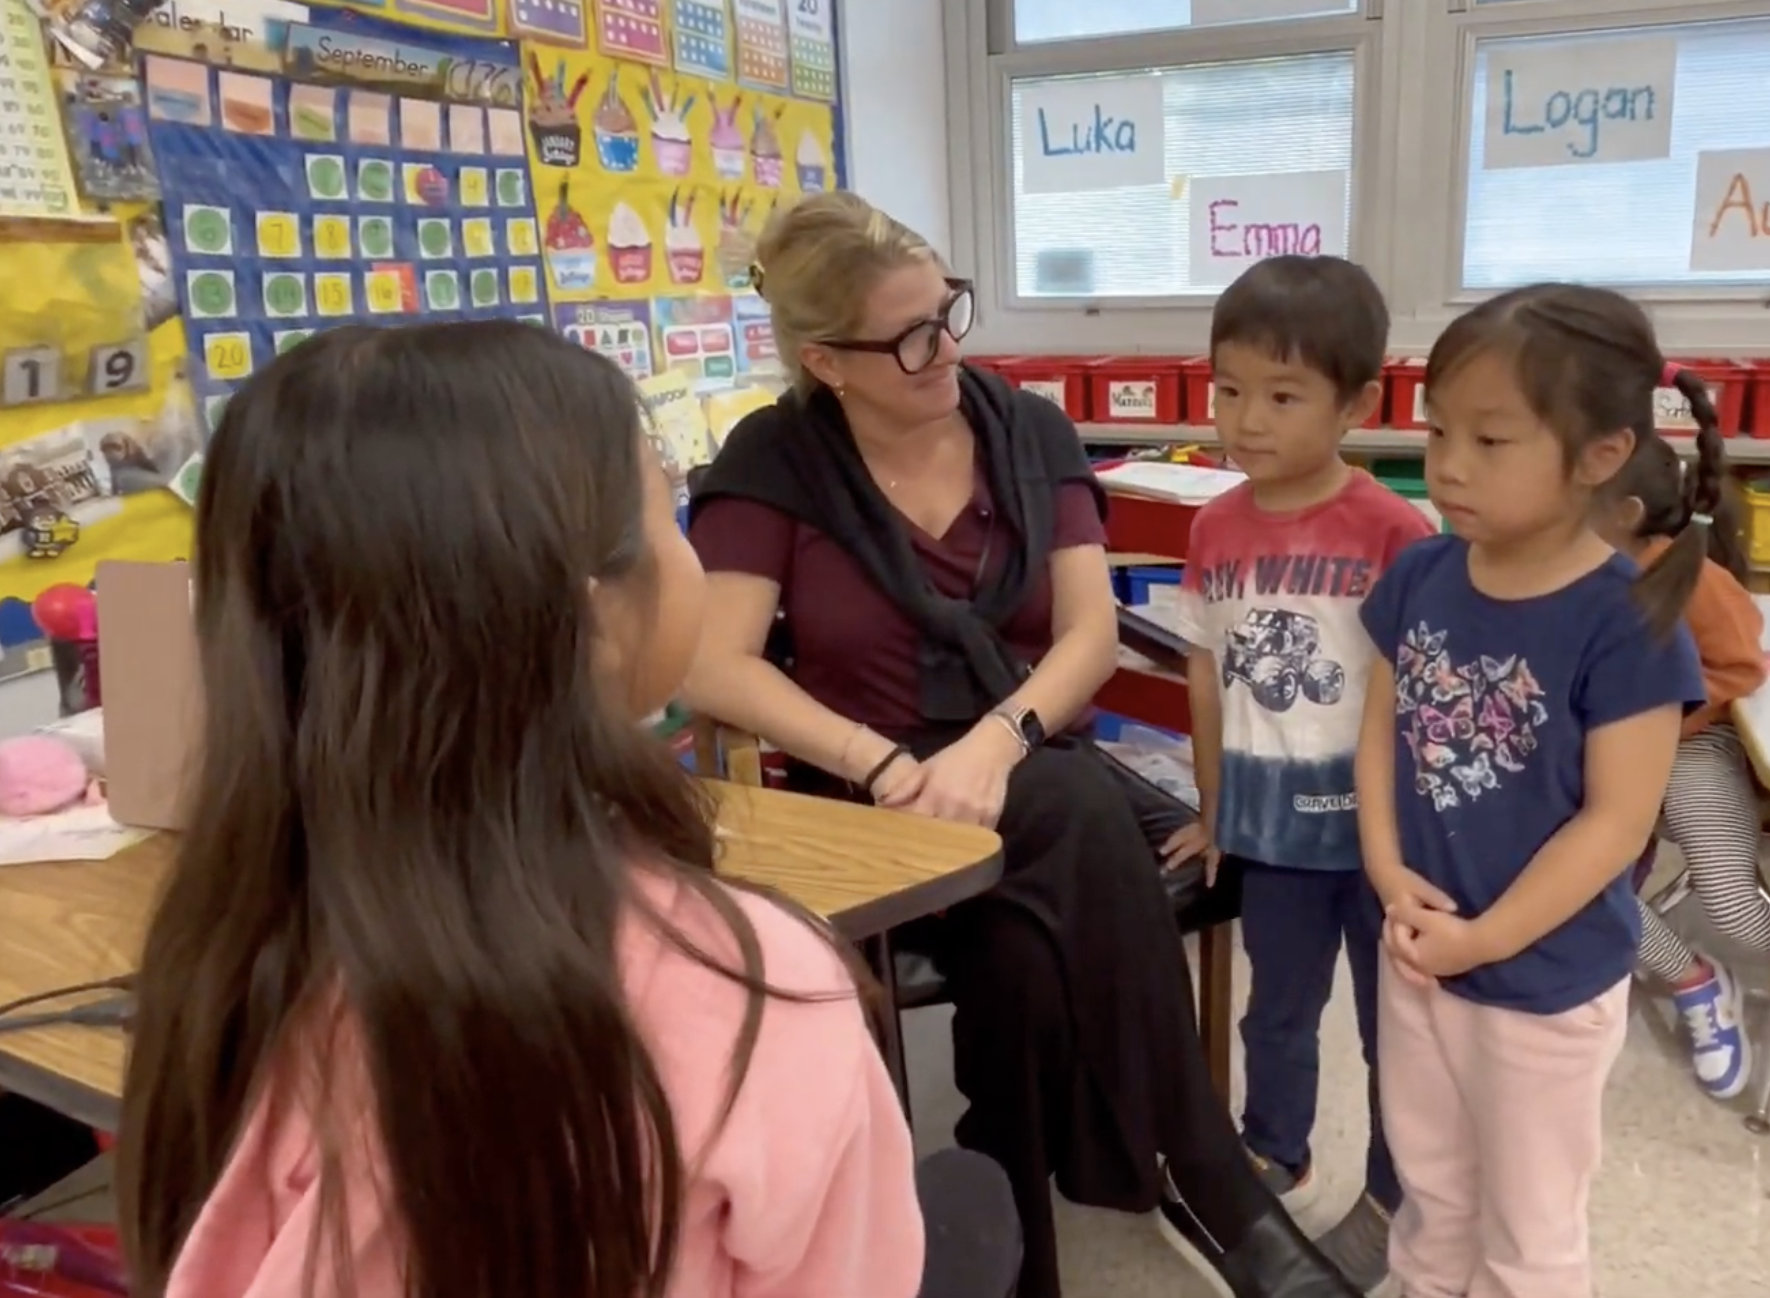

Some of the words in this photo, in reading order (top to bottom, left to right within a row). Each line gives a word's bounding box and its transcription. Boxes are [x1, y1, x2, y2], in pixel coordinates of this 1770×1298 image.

[147, 0, 254, 43] aledar
[317, 36, 430, 78] September
[1038, 103, 1136, 156] Luka
[1503, 69, 1655, 158] Logan
[1208, 198, 1322, 257] Emma
[19, 358, 41, 398] 1
[105, 350, 135, 388] 9
[214, 344, 245, 370] 20
[1256, 554, 1371, 597] WHITE
